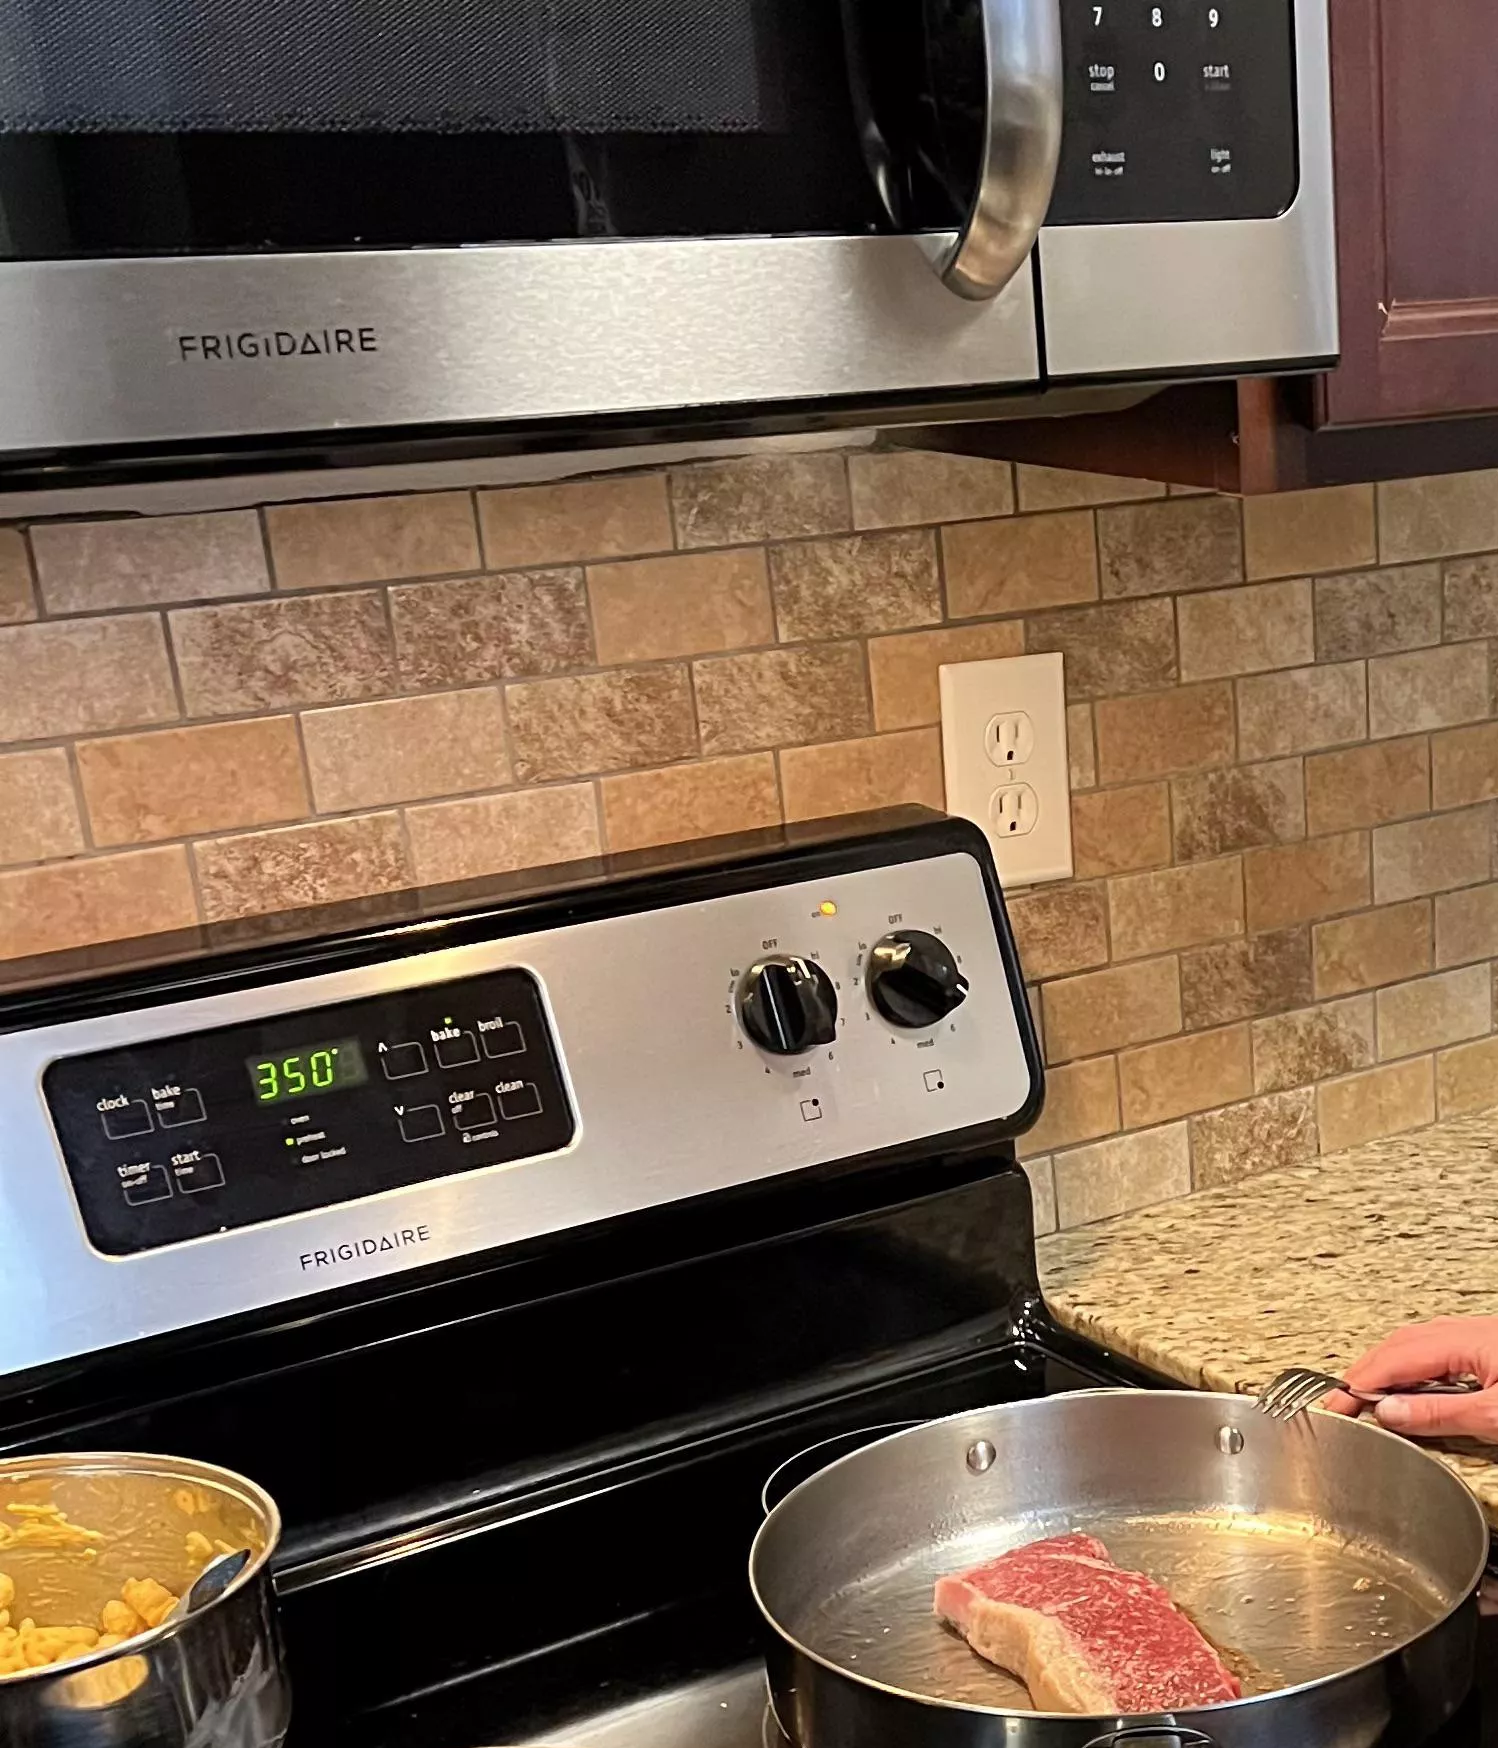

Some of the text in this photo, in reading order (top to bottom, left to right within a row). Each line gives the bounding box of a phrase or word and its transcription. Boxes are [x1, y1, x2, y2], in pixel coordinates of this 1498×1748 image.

[1092, 6, 1219, 28] 7 8 9
[1088, 63, 1115, 80] stop
[1154, 62, 1166, 82] 0
[1203, 64, 1230, 78] start
[178, 327, 377, 362] FRIGIDAIRE
[762, 938, 778, 950] OFF
[477, 1016, 504, 1032] broil
[430, 1027, 461, 1042] bake
[151, 1085, 181, 1101] bake
[495, 1080, 525, 1094] clean
[96, 1094, 130, 1112] clock
[448, 1090, 475, 1104] clear
[171, 1150, 201, 1166] start
[117, 1162, 151, 1178] timer
[299, 1224, 431, 1271] FRIGIDAIRE
